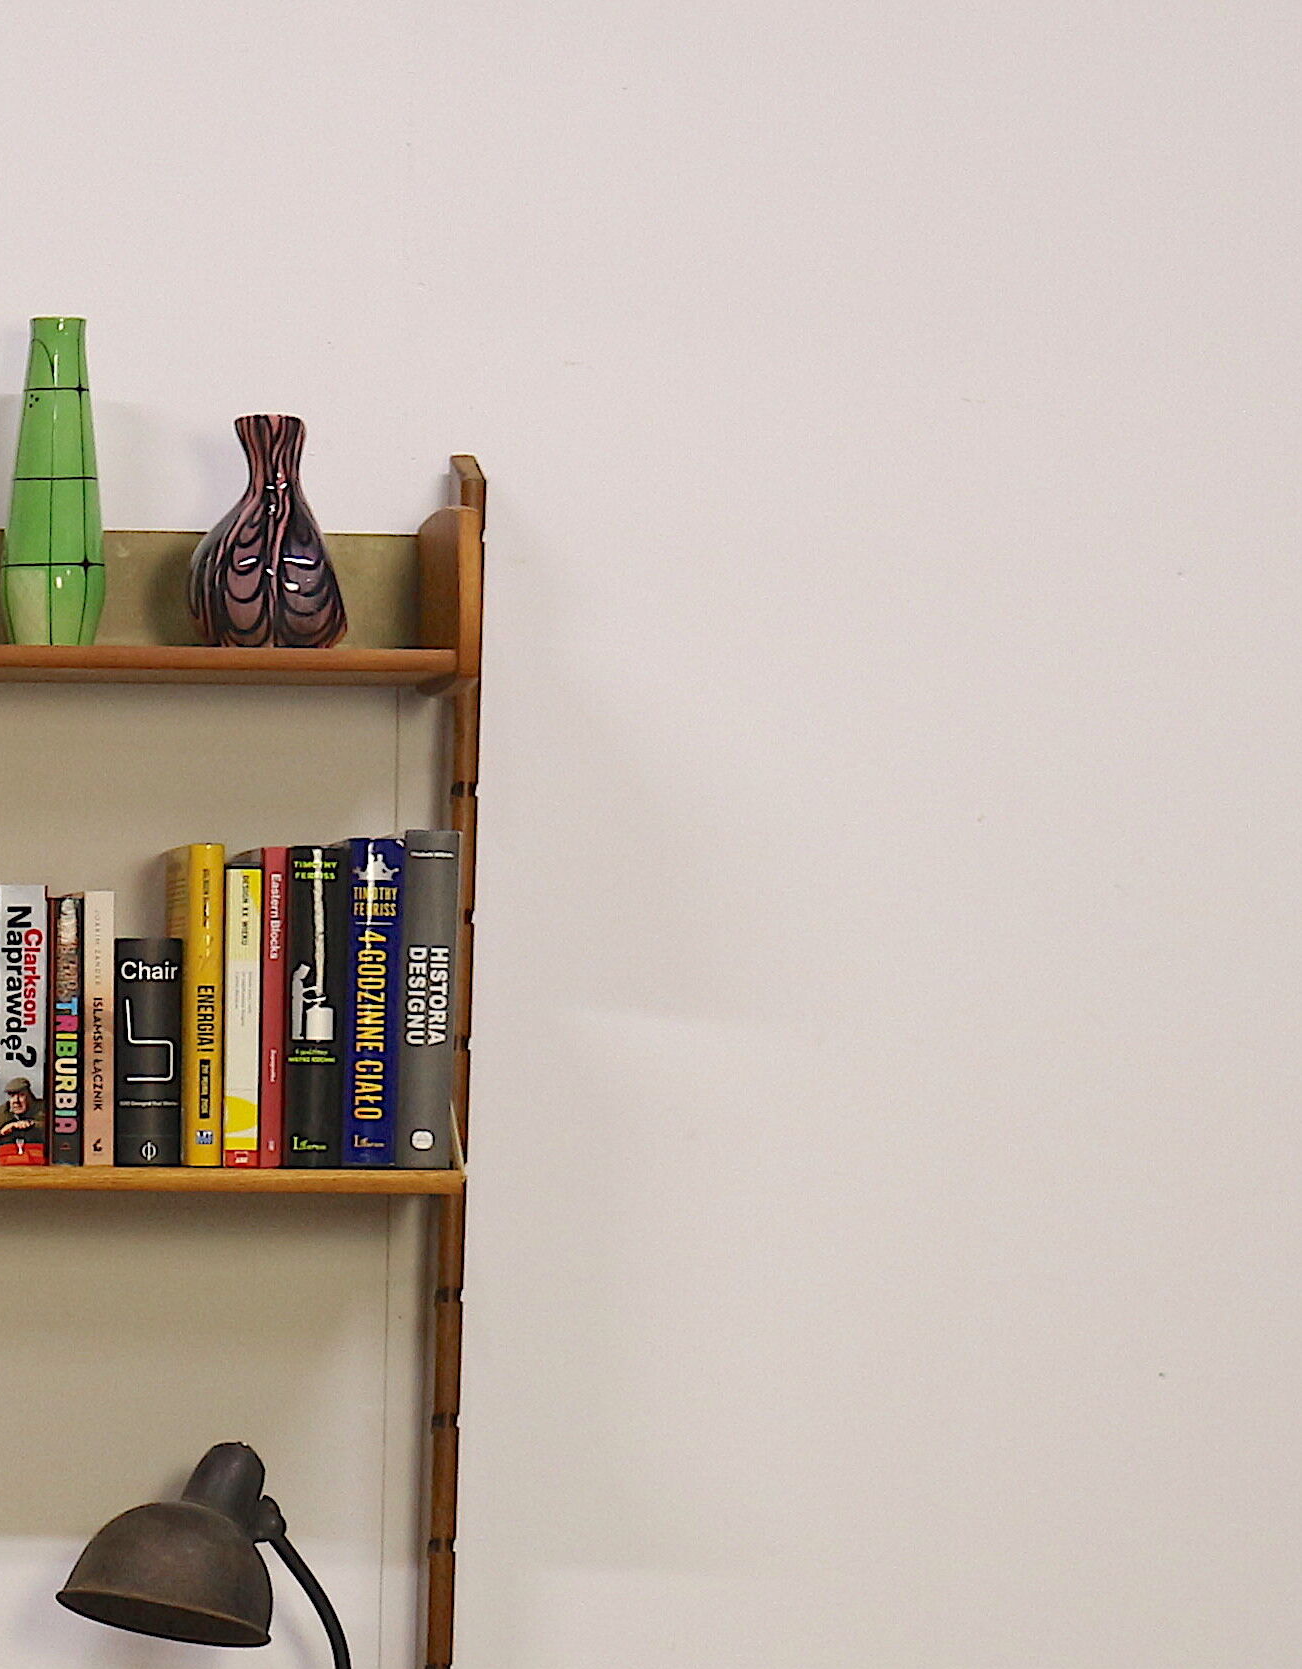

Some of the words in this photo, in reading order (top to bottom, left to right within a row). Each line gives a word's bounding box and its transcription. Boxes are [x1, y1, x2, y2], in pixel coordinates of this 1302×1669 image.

[270, 873, 283, 918] Eastern
[269, 920, 282, 960] Blocks
[23, 928, 44, 1026] Clarkson
[120, 961, 179, 980] Chair
[406, 946, 427, 1046] DESIGNU
[428, 947, 450, 1046] HISTORIA
[93, 997, 104, 1054] ISLAMSKI
[196, 985, 215, 1053] ENERGIA!
[55, 997, 79, 1133] TRIBURBIA
[92, 1059, 104, 1111] ŁĄCZNIK
[354, 1060, 384, 1120] CIAŁO
